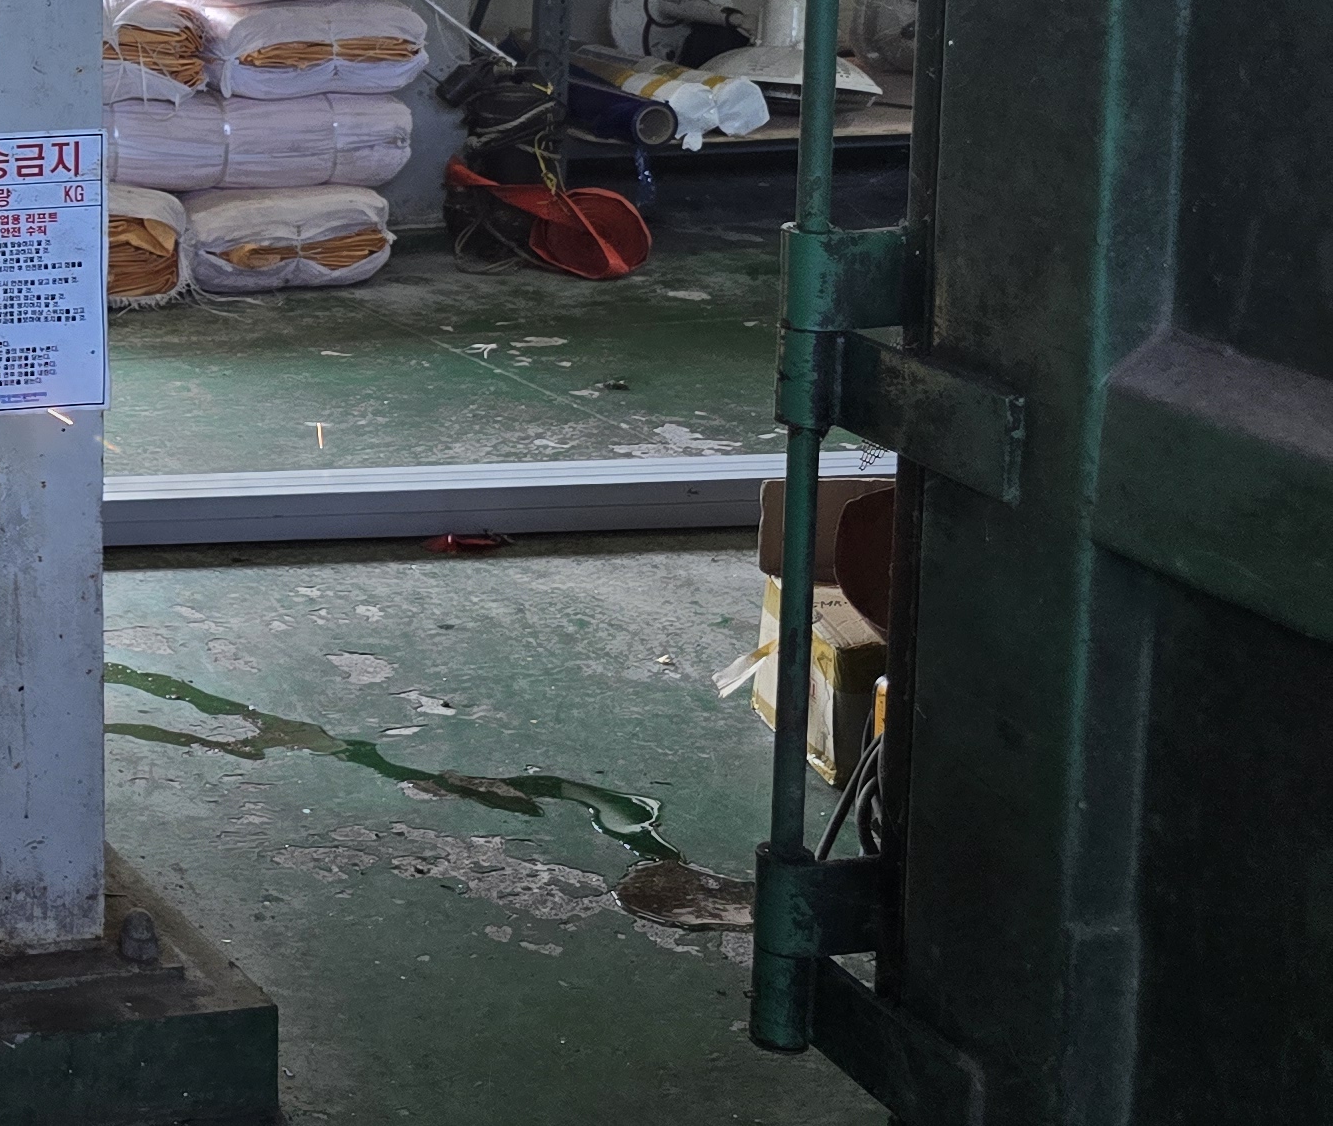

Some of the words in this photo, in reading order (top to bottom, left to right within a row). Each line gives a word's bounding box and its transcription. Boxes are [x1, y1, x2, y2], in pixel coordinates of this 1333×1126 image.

[63, 185, 84, 203] KG
[25, 212, 58, 224] 리프트
[0, 227, 21, 238] 안전
